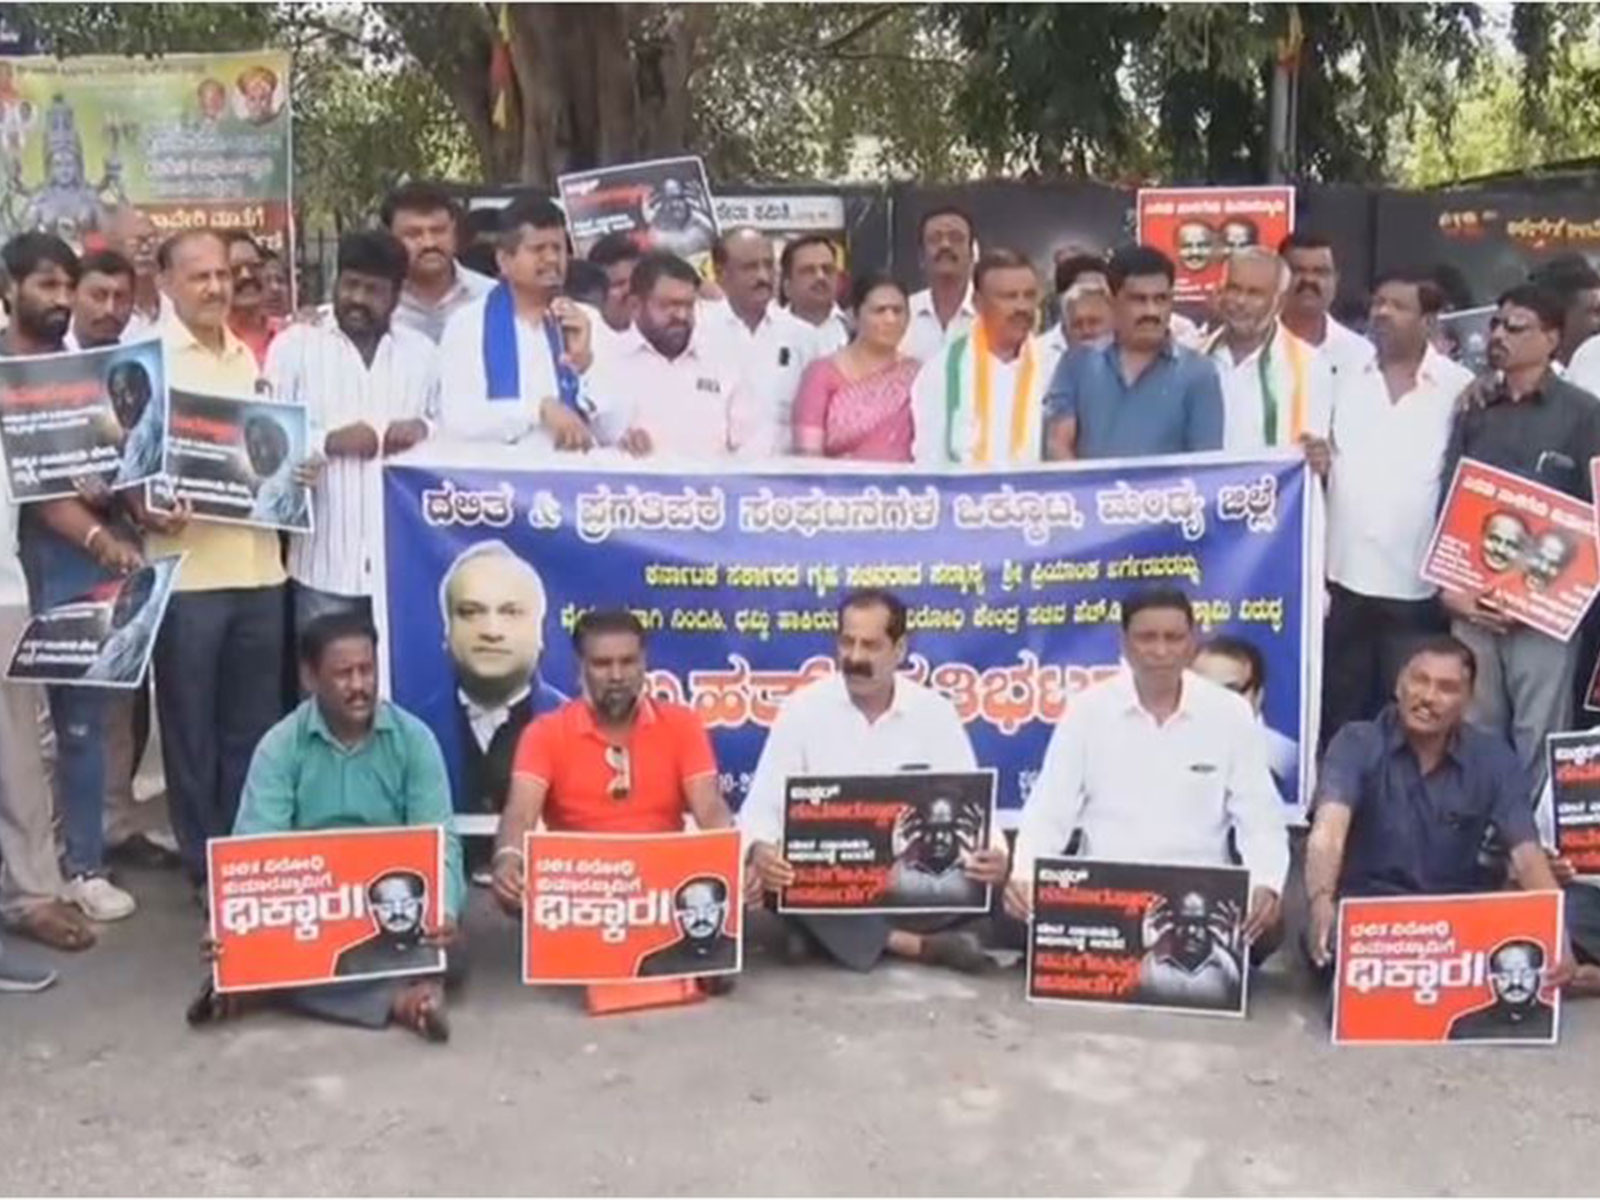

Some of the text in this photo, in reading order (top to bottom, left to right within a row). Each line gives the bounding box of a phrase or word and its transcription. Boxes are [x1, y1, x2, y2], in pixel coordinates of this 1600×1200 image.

[422, 480, 514, 526] ದಲಿತ
[576, 484, 724, 543] ಪ್ರಗತಿಪರ
[739, 485, 939, 537] ಸಂಘಟನೆಗಳ
[1097, 478, 1205, 540] ಮಂಡ್ಯ
[1218, 474, 1277, 532] ಜಿಲ್ಲೆ
